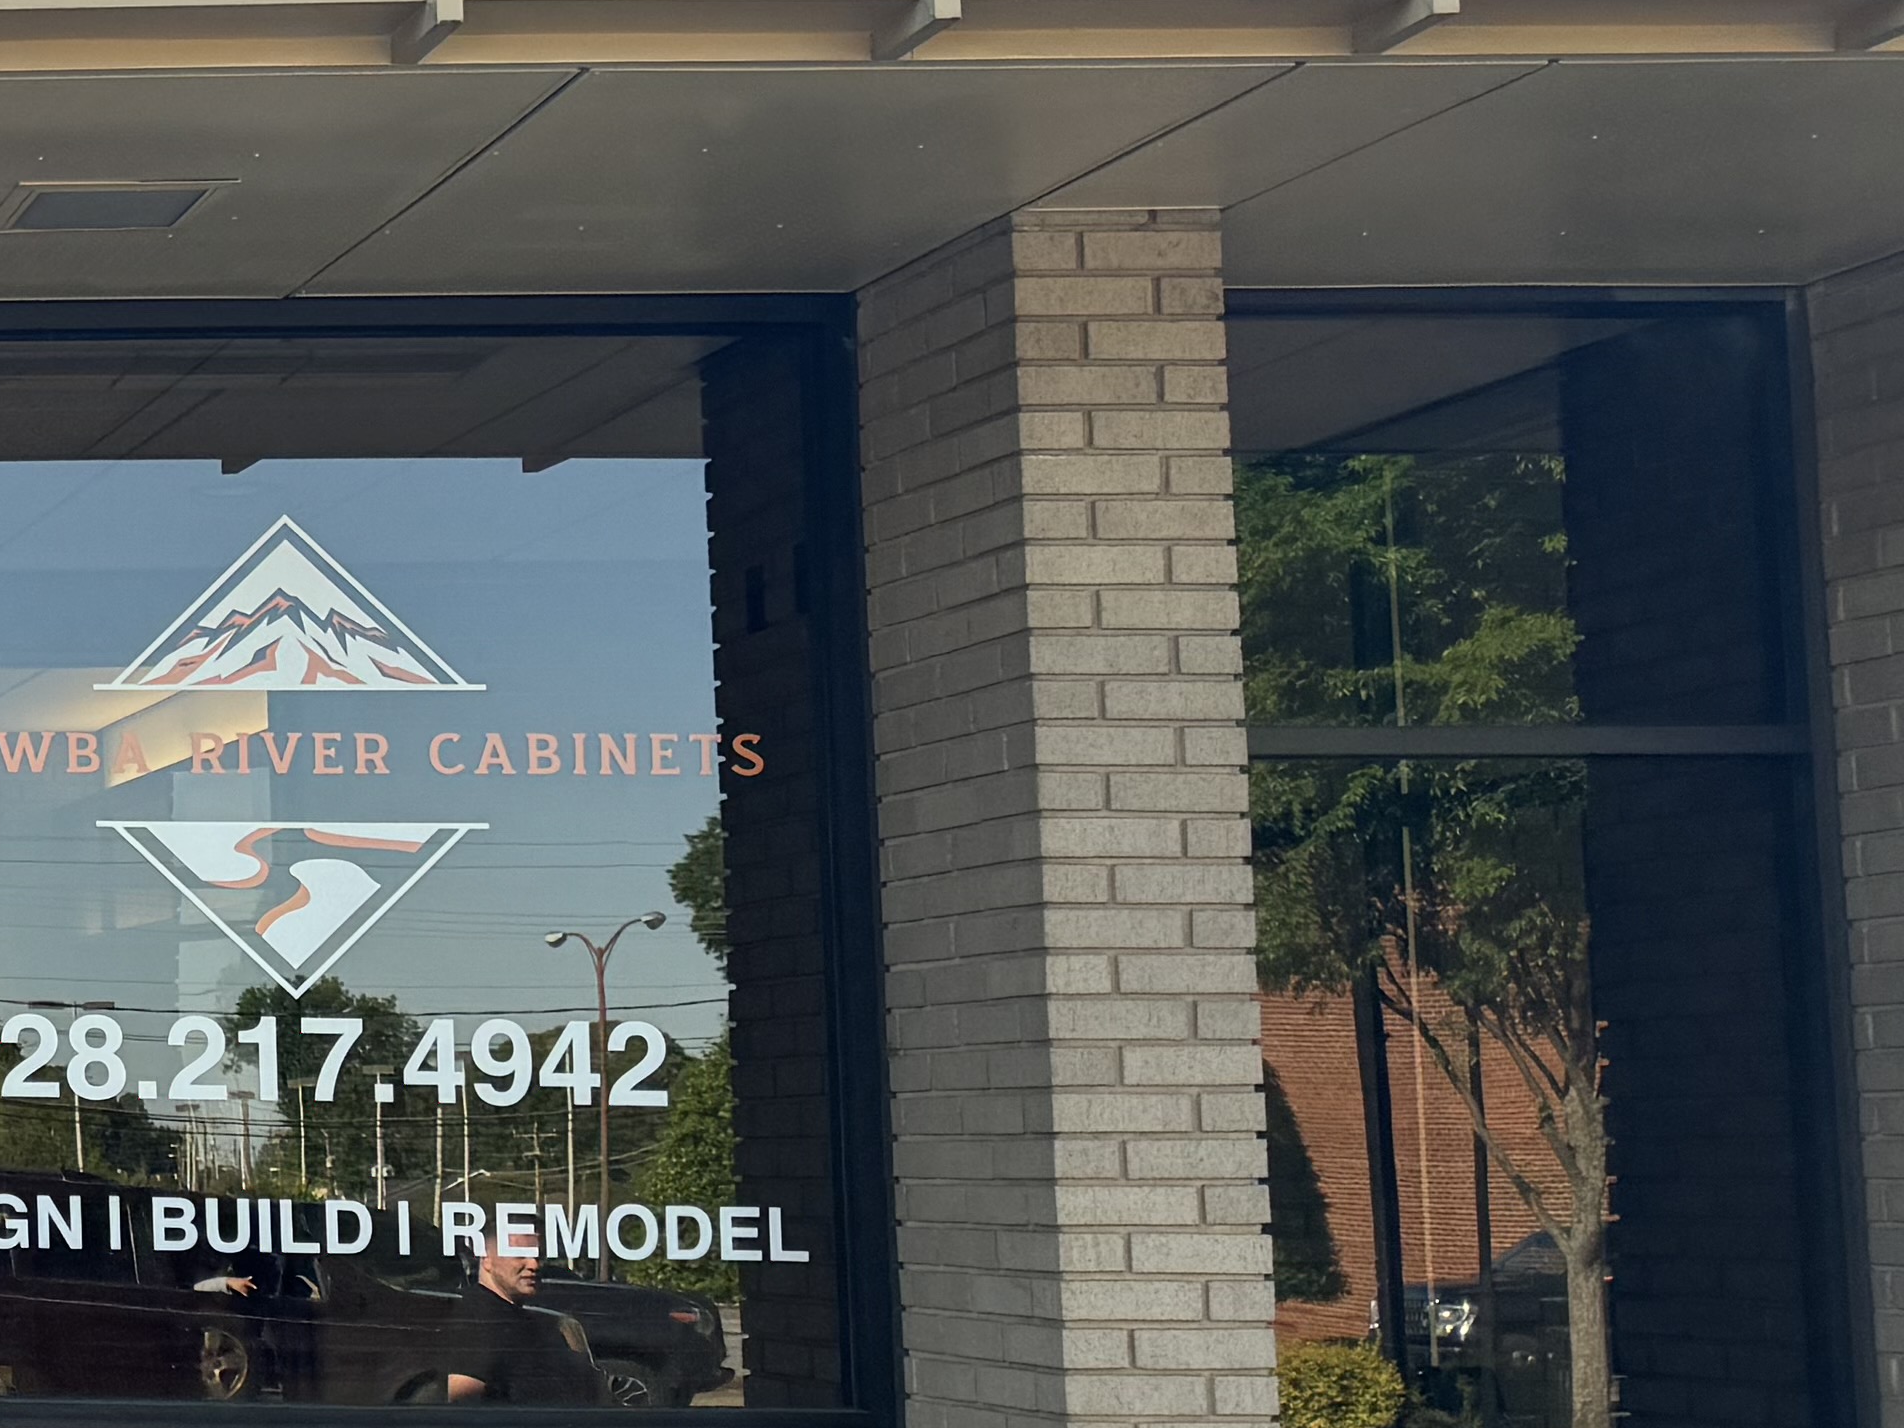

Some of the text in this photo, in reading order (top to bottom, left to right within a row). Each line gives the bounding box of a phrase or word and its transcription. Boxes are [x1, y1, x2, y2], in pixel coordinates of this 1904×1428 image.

[189, 732, 391, 775] RIVER
[428, 732, 766, 777] CABINETS
[153, 1196, 374, 1257] BUILD
[443, 1202, 809, 1264] REMODEL
